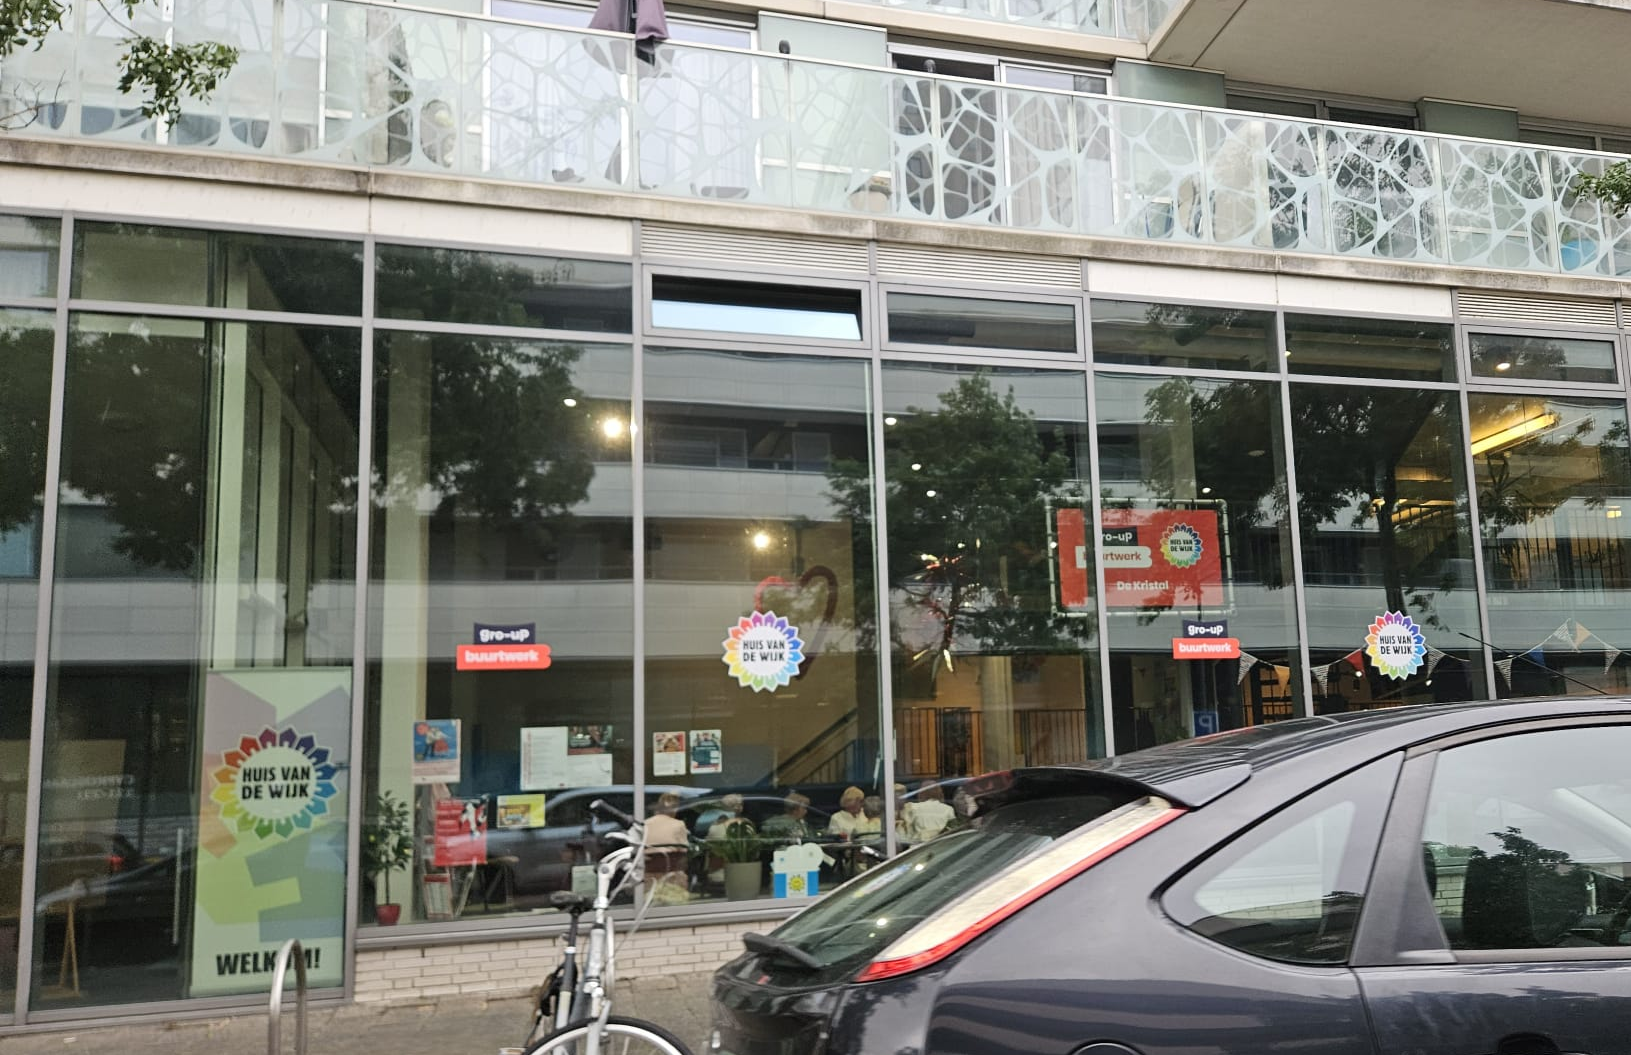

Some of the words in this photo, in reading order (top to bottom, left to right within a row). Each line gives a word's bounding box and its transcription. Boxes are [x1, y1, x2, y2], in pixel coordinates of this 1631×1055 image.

[1102, 532, 1133, 542] ro-up
[1083, 551, 1142, 561] rtwerk
[1116, 581, 1132, 590] De
[1134, 580, 1169, 590] Kristal
[479, 628, 530, 642] gro-up
[1188, 625, 1224, 636] gro-up
[742, 640, 764, 650] HUIS
[767, 640, 785, 650] VAN
[1379, 635, 1396, 645] HUIS
[1397, 635, 1412, 644] VAN
[1178, 642, 1232, 653] buurtwerk
[1380, 645, 1391, 655] DE
[1392, 645, 1412, 655] WIJK
[465, 649, 539, 663] buurtwerk
[743, 652, 757, 662] DE
[759, 651, 785, 662] WIJK
[242, 767, 277, 782] HUIS
[281, 766, 311, 781] VAN
[241, 785, 263, 800] DE
[268, 783, 309, 798] WIJK
